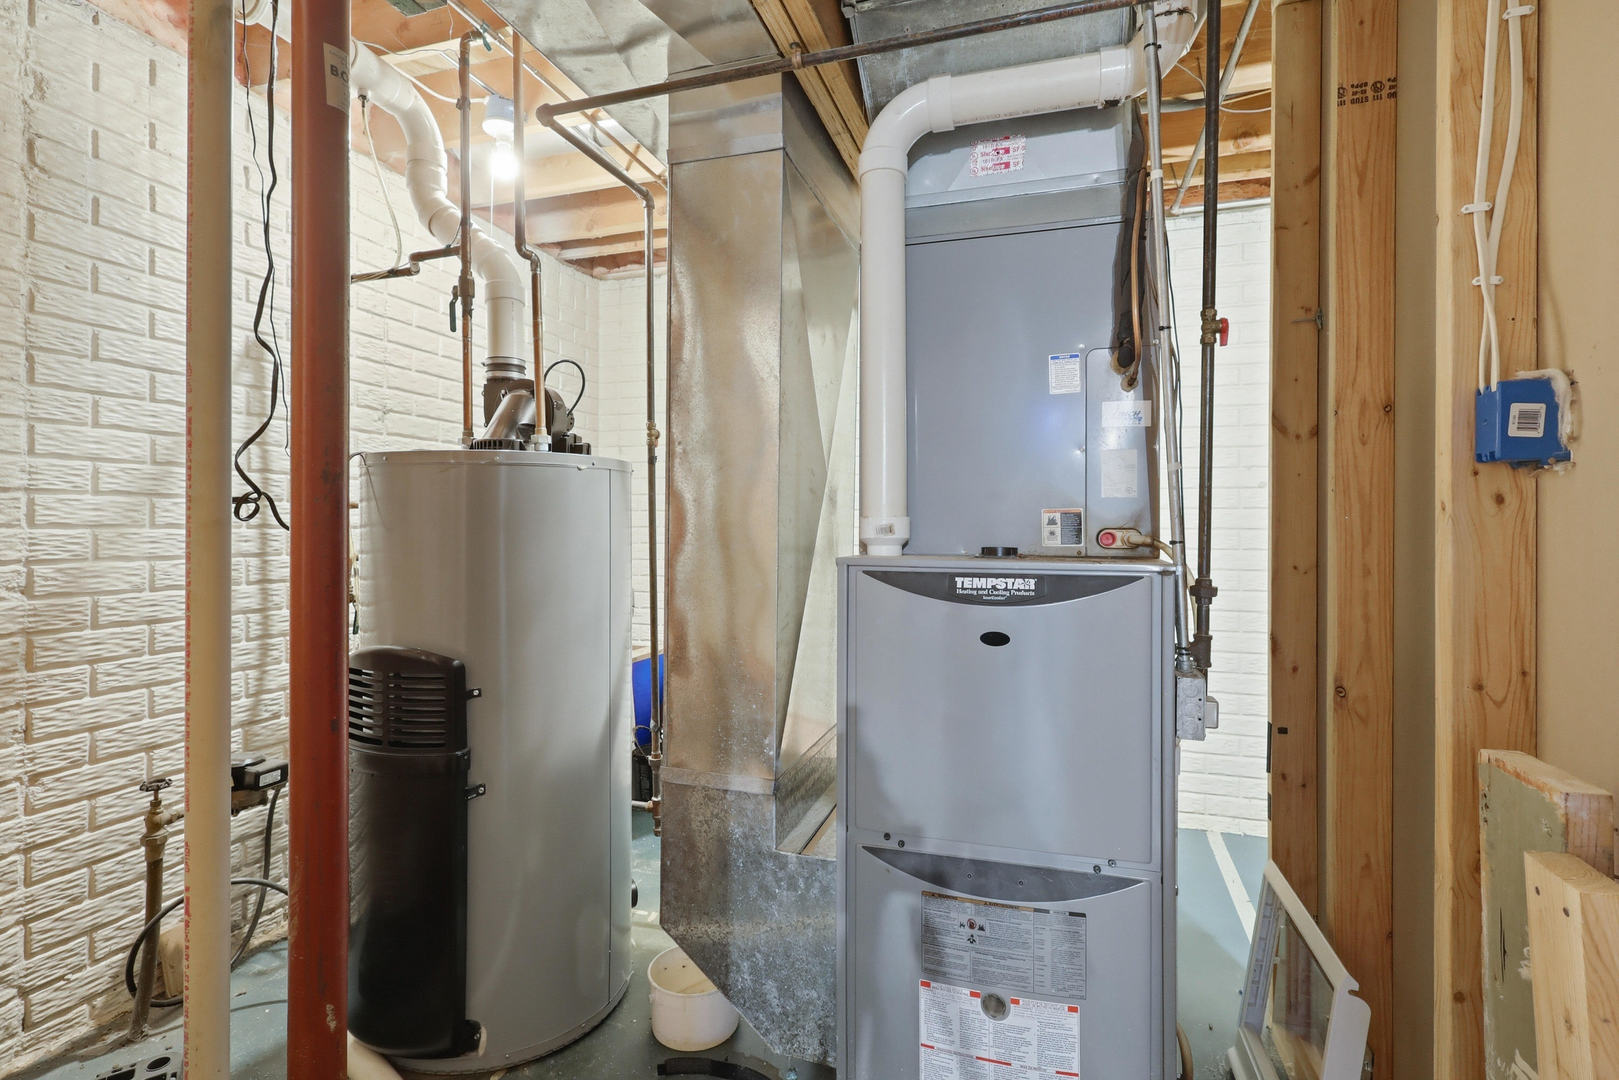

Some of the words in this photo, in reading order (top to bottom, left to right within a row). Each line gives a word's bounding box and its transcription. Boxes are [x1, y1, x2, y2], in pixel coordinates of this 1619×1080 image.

[1350, 95, 1369, 105] STUD
[955, 576, 1036, 590] TEMPSTAR
[956, 588, 978, 596] Heating
[989, 589, 1010, 597] Cooling
